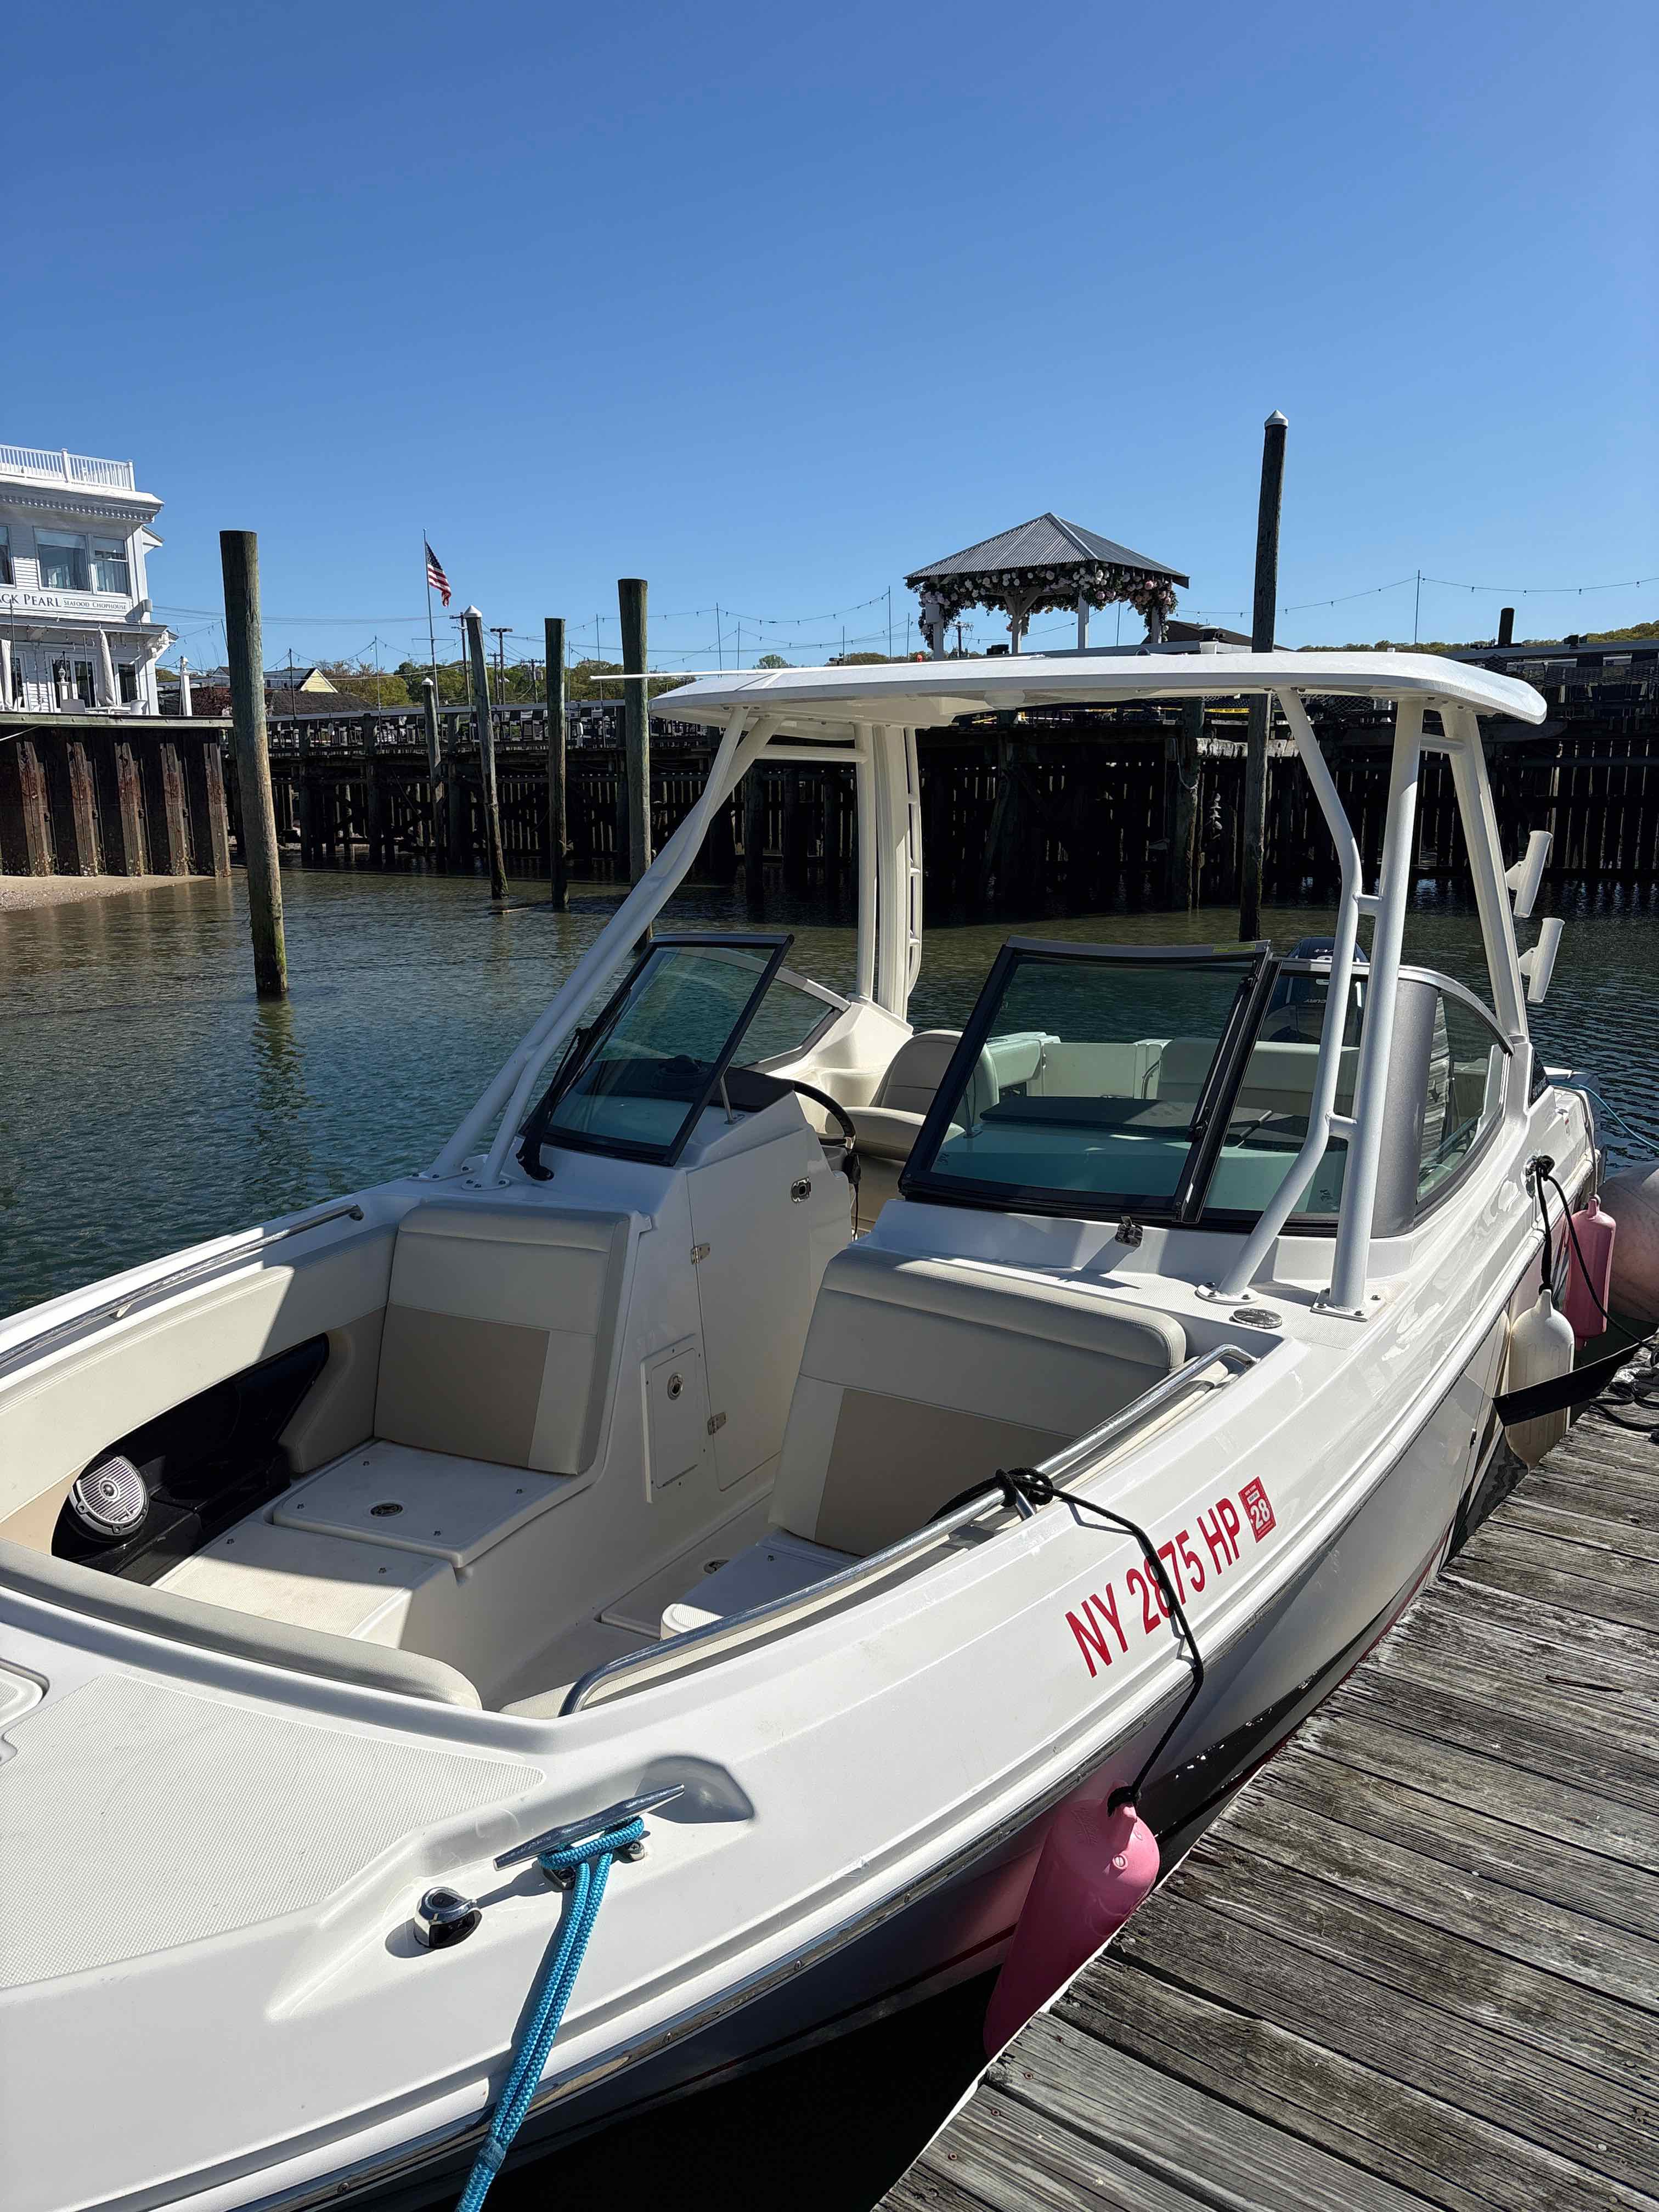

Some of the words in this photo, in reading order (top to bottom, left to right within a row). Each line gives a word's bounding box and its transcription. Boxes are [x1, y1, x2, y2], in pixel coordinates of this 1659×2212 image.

[0, 593, 19, 604] CK
[24, 594, 61, 607] PEARL
[92, 602, 127, 610] CHOPHOUSE
[1250, 1498, 1271, 1530] 28
[1065, 1582, 1128, 1678] NY
[1197, 1498, 1240, 1575] HP
